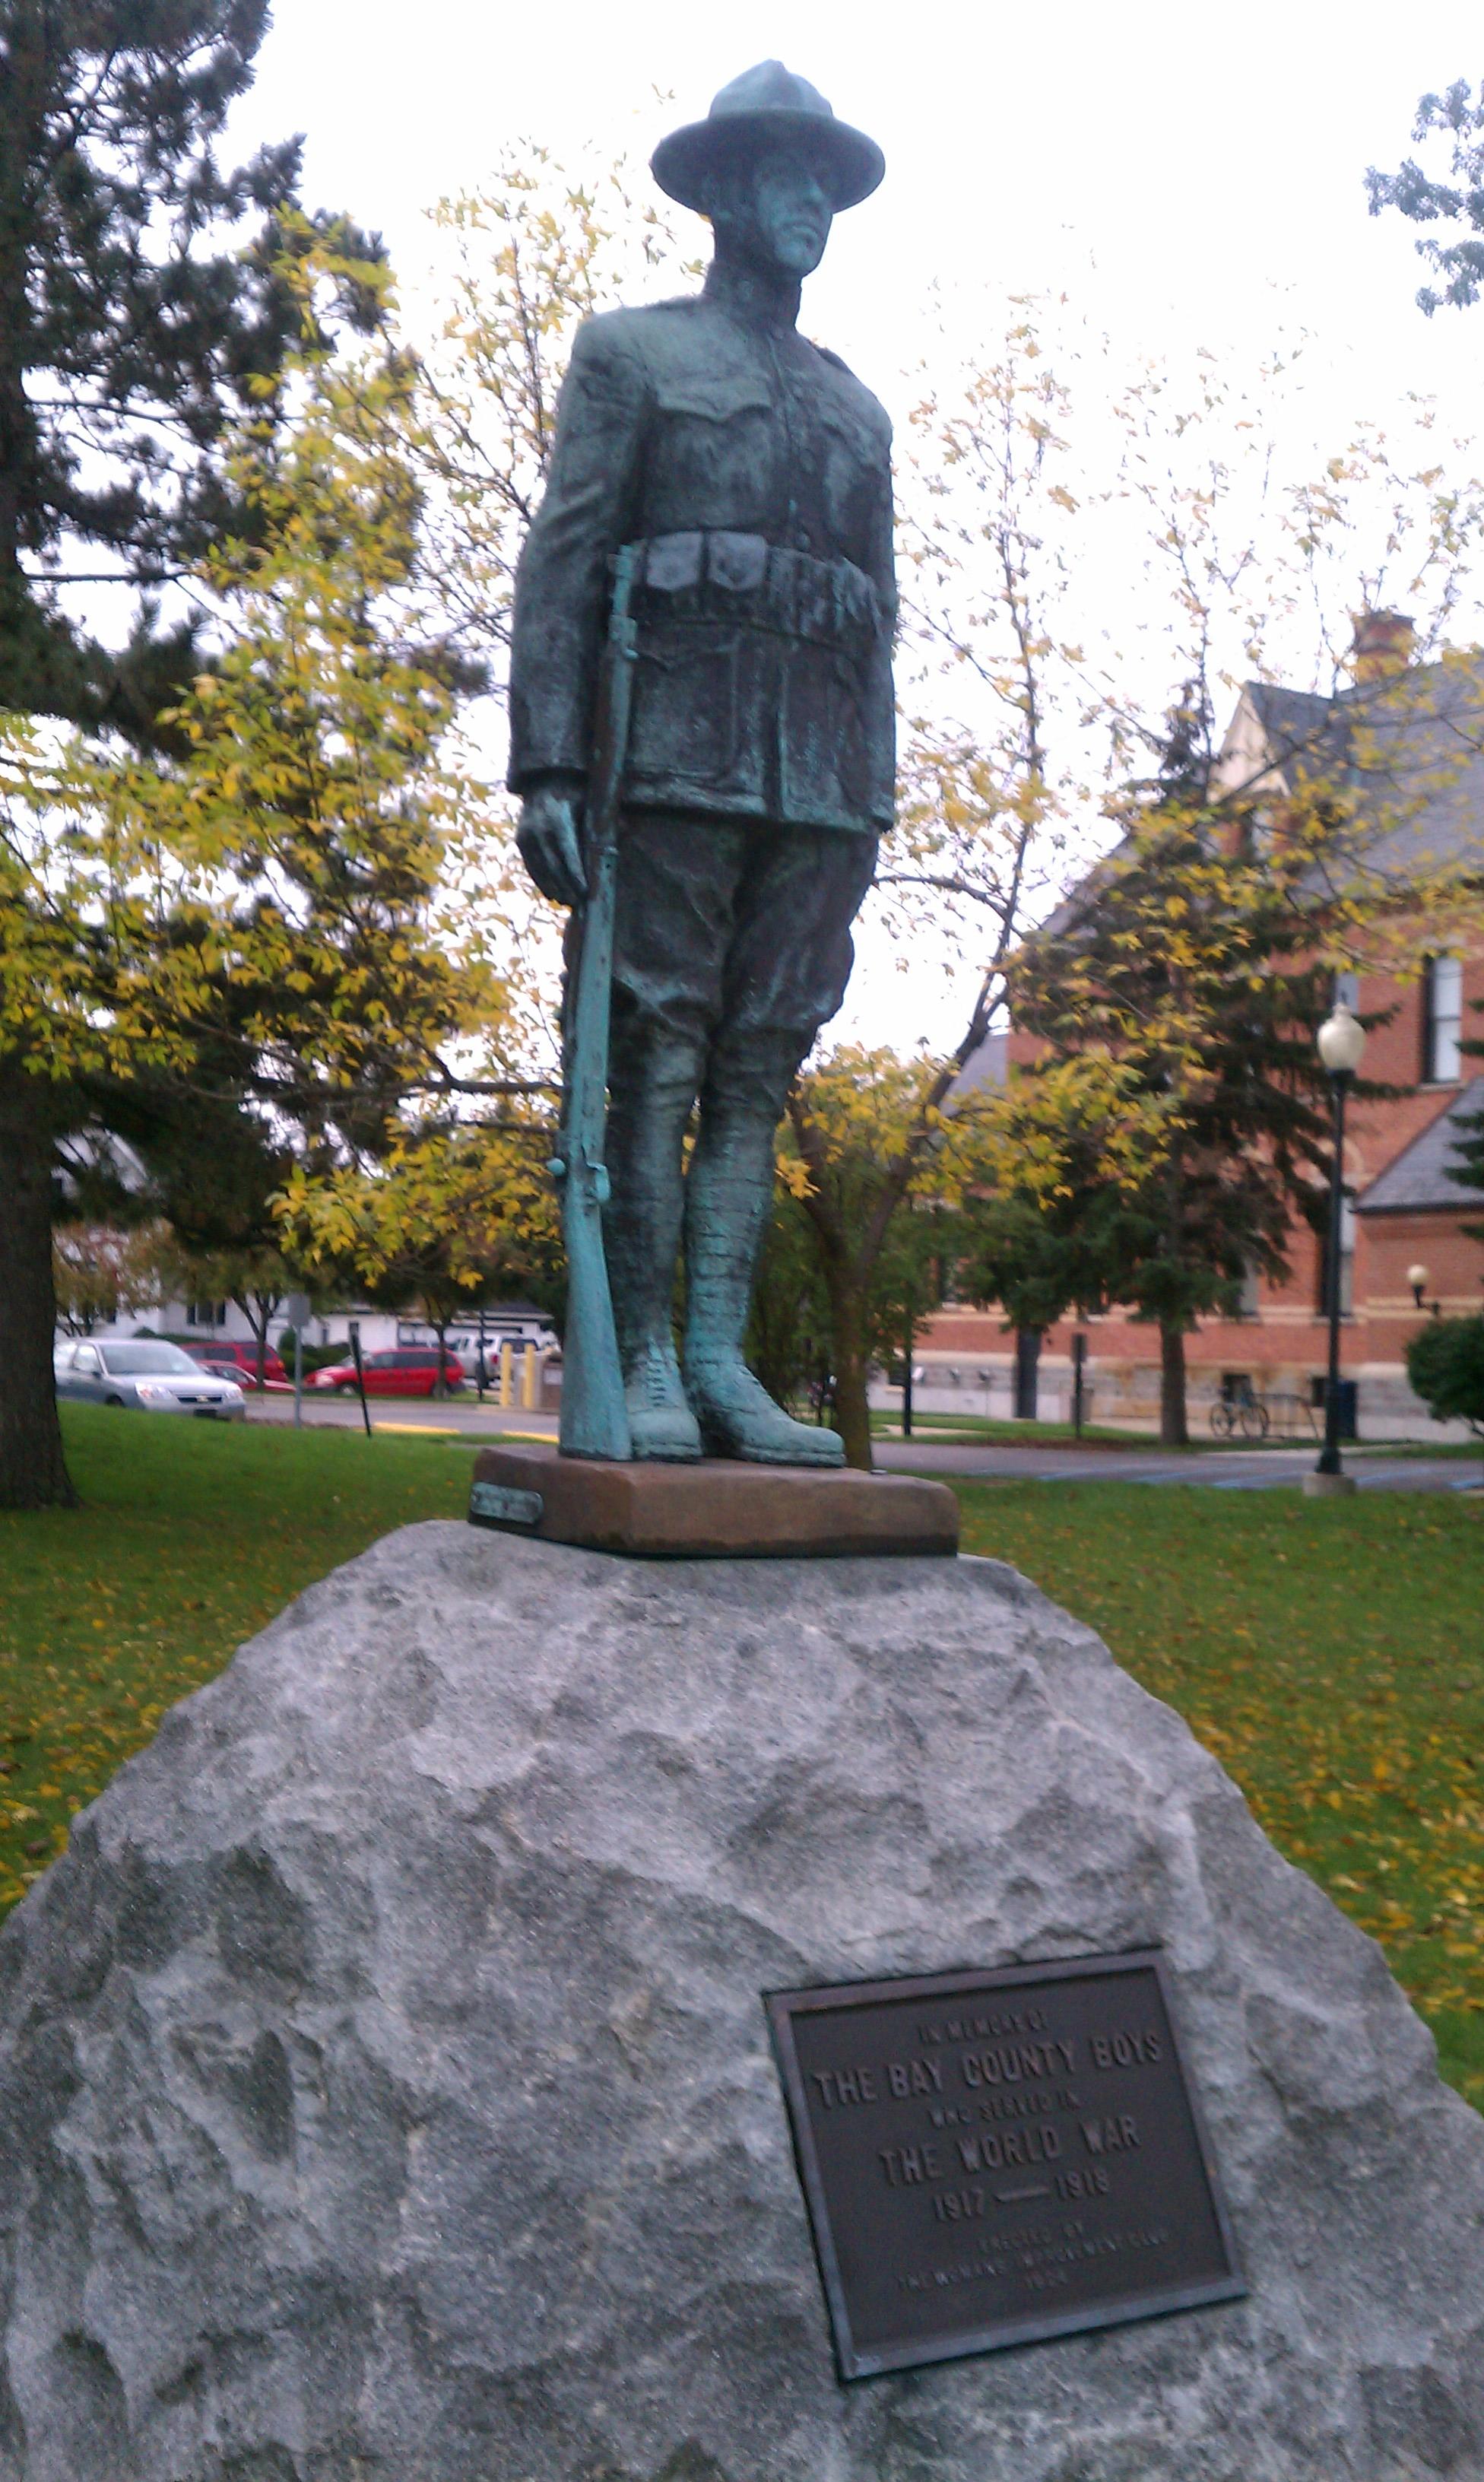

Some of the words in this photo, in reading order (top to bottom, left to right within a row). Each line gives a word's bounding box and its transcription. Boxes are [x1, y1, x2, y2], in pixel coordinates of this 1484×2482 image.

[815, 2066, 877, 2107] THE
[887, 2057, 946, 2097] BAY
[962, 2039, 1077, 2087] COUNTY
[1092, 2028, 1162, 2068] BOYS
[880, 2144, 942, 2185] THE
[958, 2125, 1063, 2173] WORLD
[1082, 2115, 1141, 2154] WAR
[934, 2187, 987, 2220] 1917
[1056, 2167, 1111, 2200] 1918
